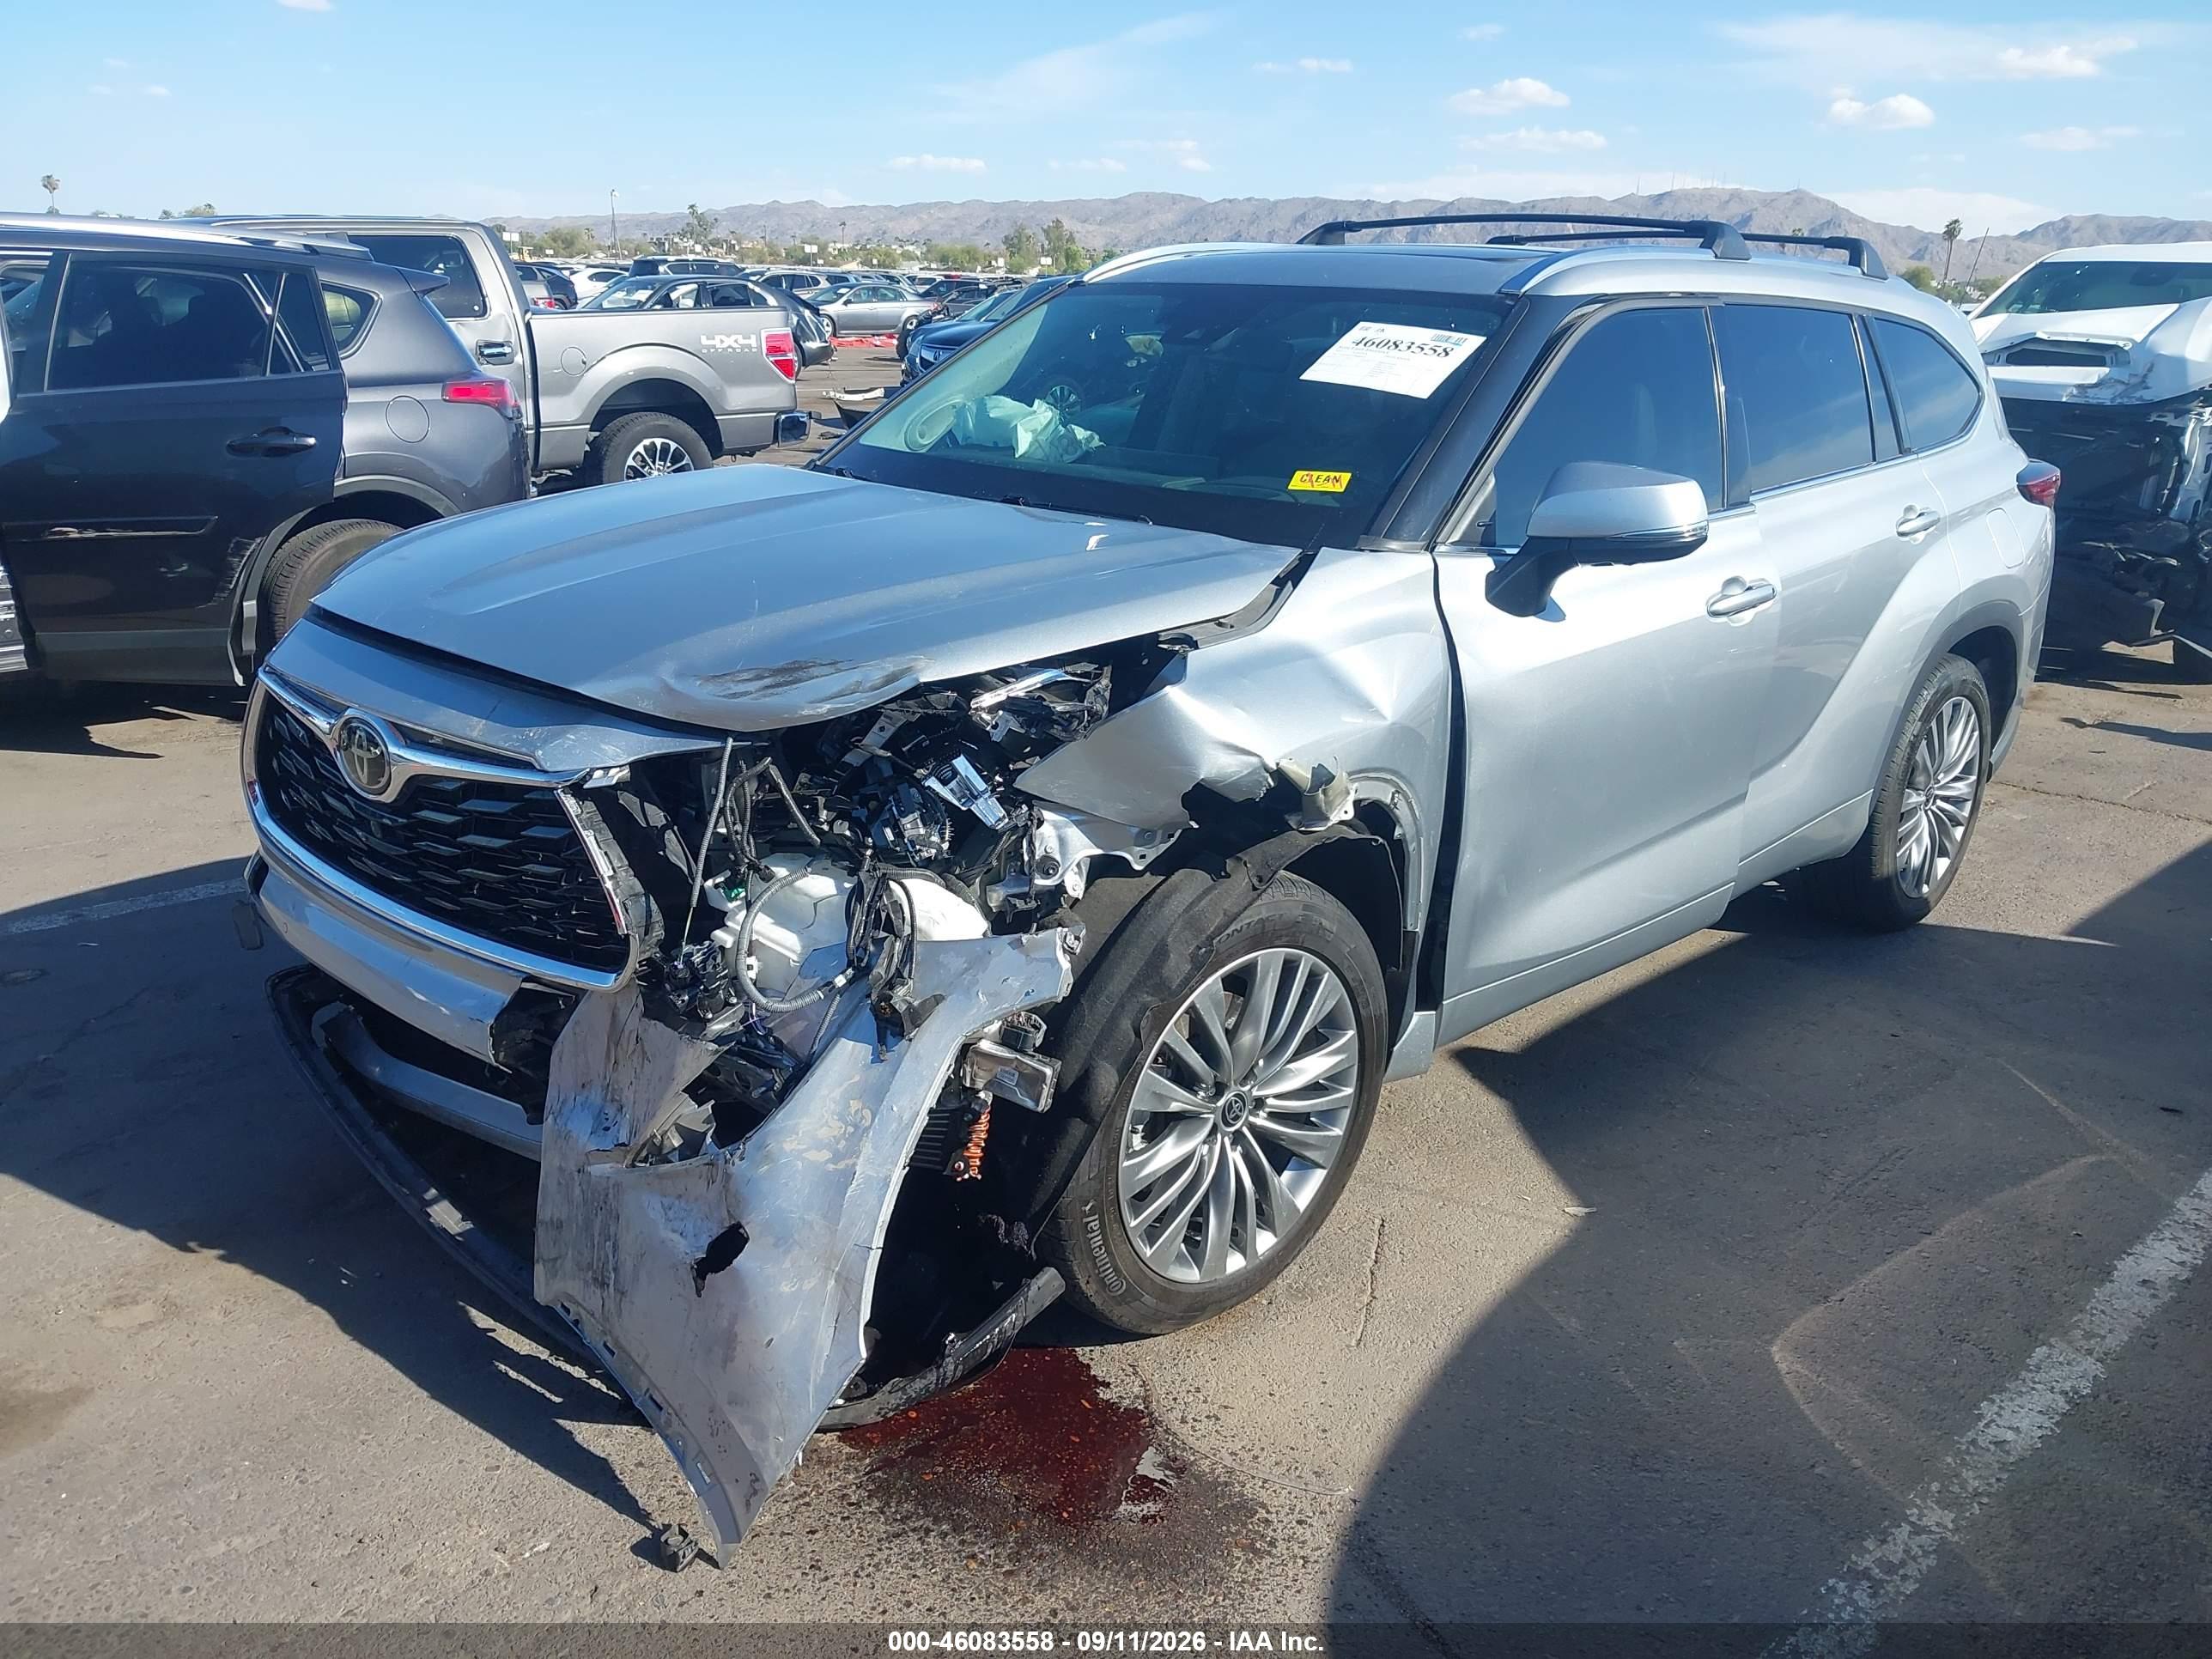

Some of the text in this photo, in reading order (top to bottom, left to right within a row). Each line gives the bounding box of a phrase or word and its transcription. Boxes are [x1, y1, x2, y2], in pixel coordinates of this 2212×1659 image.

[700, 334, 757, 349] 4X4
[1352, 336, 1455, 358] 46083558
[1216, 912, 1285, 945] ONTACT
[1082, 1214, 1127, 1297] Continental
